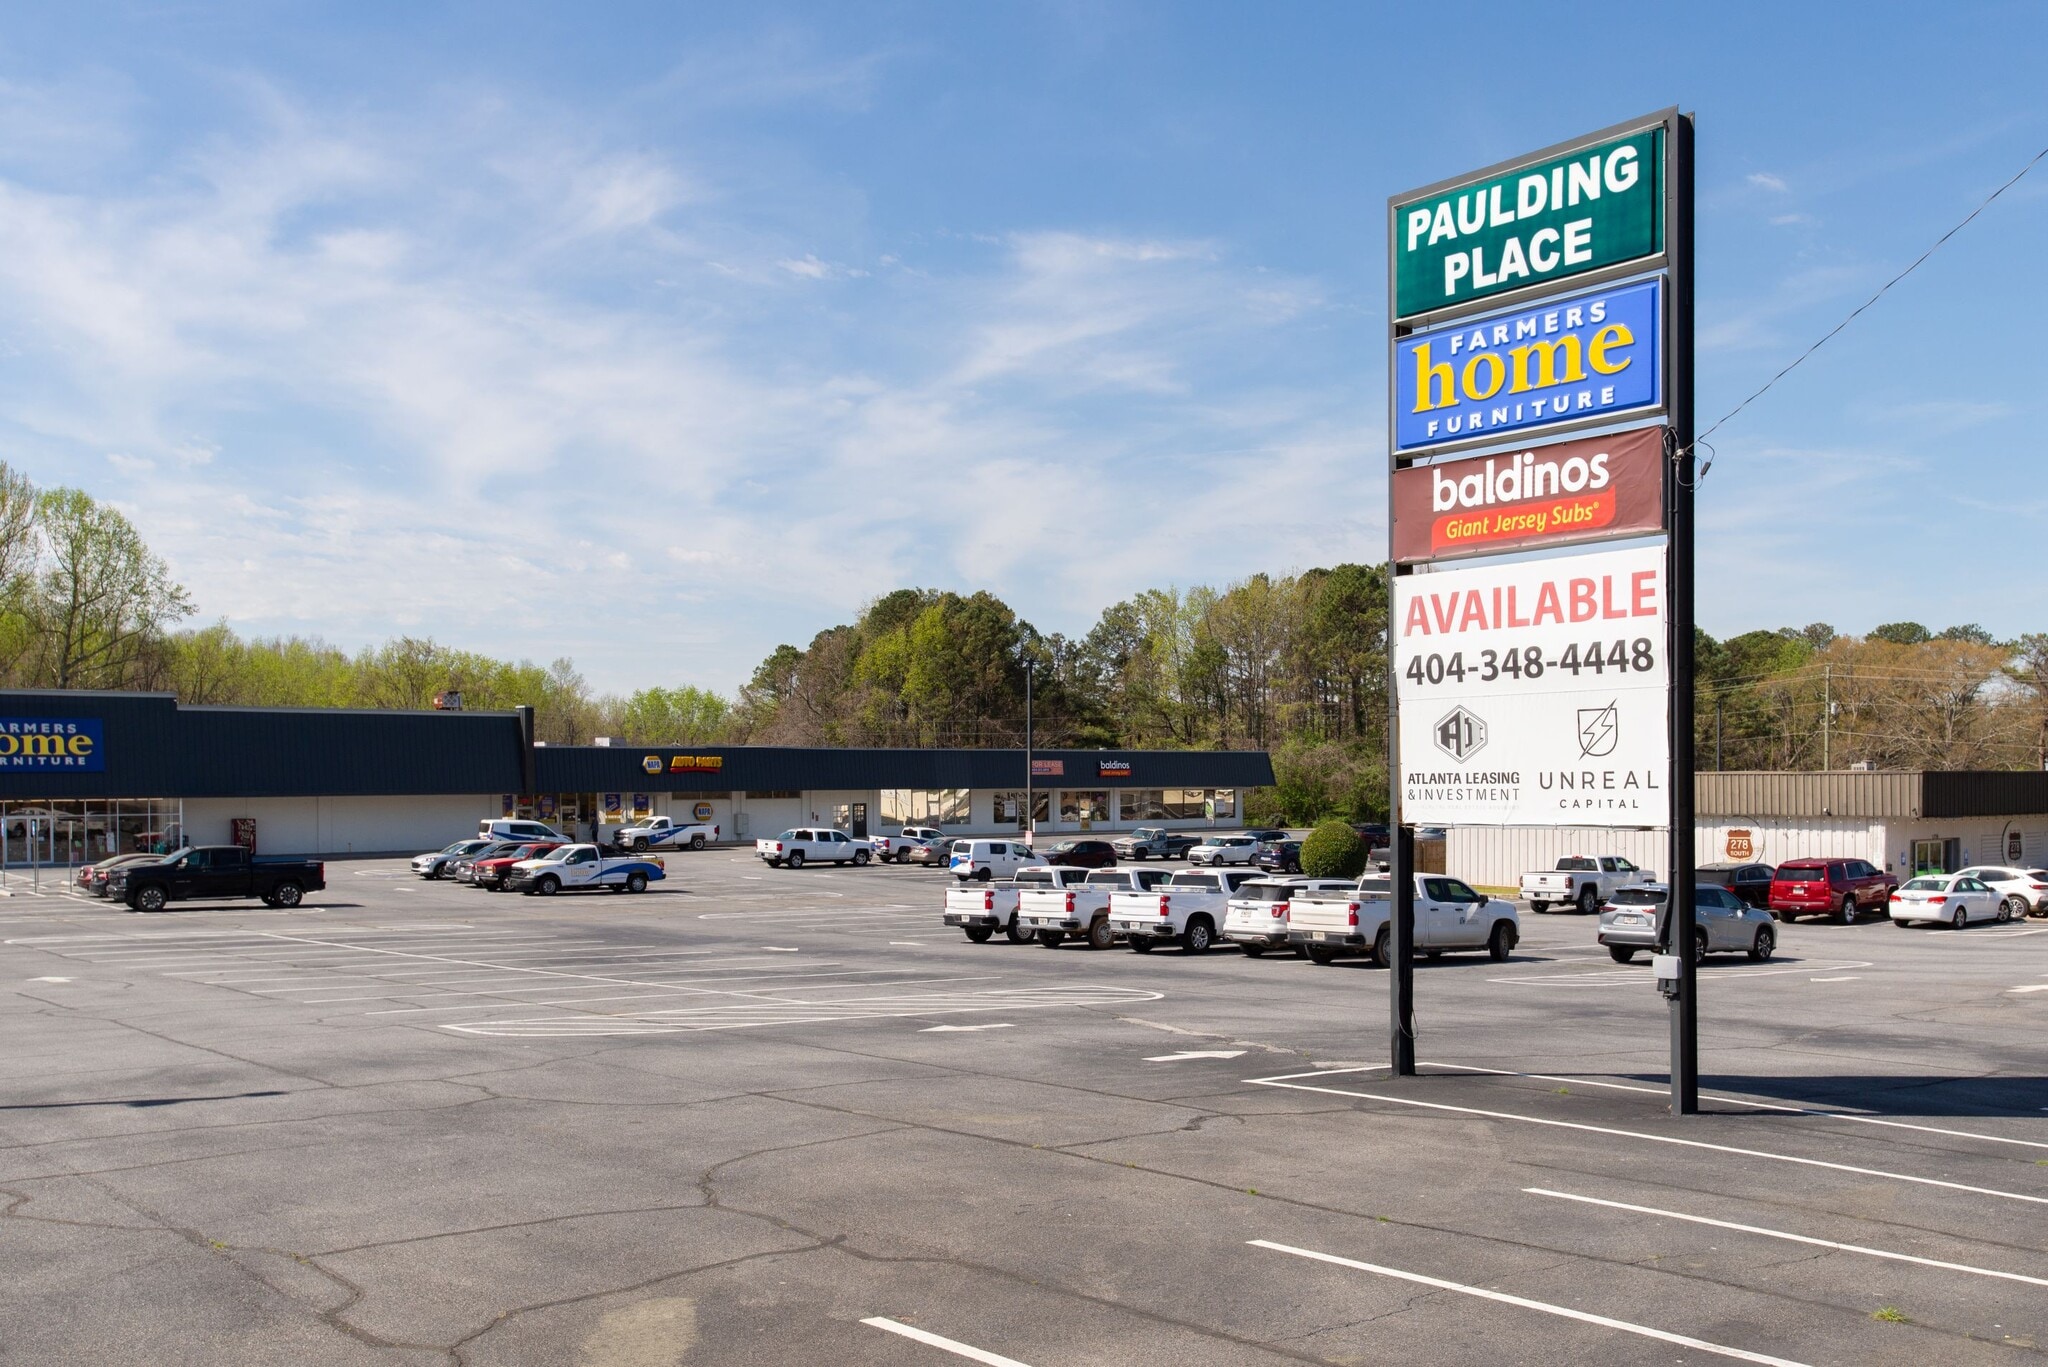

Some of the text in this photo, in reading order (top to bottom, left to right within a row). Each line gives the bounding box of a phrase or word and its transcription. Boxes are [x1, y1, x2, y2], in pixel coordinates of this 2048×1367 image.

[1407, 145, 1639, 252] PAULDING
[1444, 217, 1593, 297] PLACE
[1450, 301, 1607, 355] FARMERS
[1412, 323, 1636, 413] home
[1427, 385, 1615, 437] FURNITURE
[1433, 452, 1611, 512] baldinos
[1446, 516, 1490, 539] Giant
[1494, 509, 1547, 533] Jersey
[1404, 570, 1658, 637] AVAILABLE
[1406, 637, 1655, 686] 404-348-4448
[647, 761, 660, 769] NAPA
[671, 756, 723, 768] AUTO PARTS
[1100, 760, 1130, 769] baldinos
[1408, 772, 1520, 784] ATLANTA LEASING
[1539, 770, 1659, 790] UNREAL
[698, 808, 711, 816] NAPA
[1559, 798, 1639, 809] CAPITAL
[1730, 839, 1748, 850] 278
